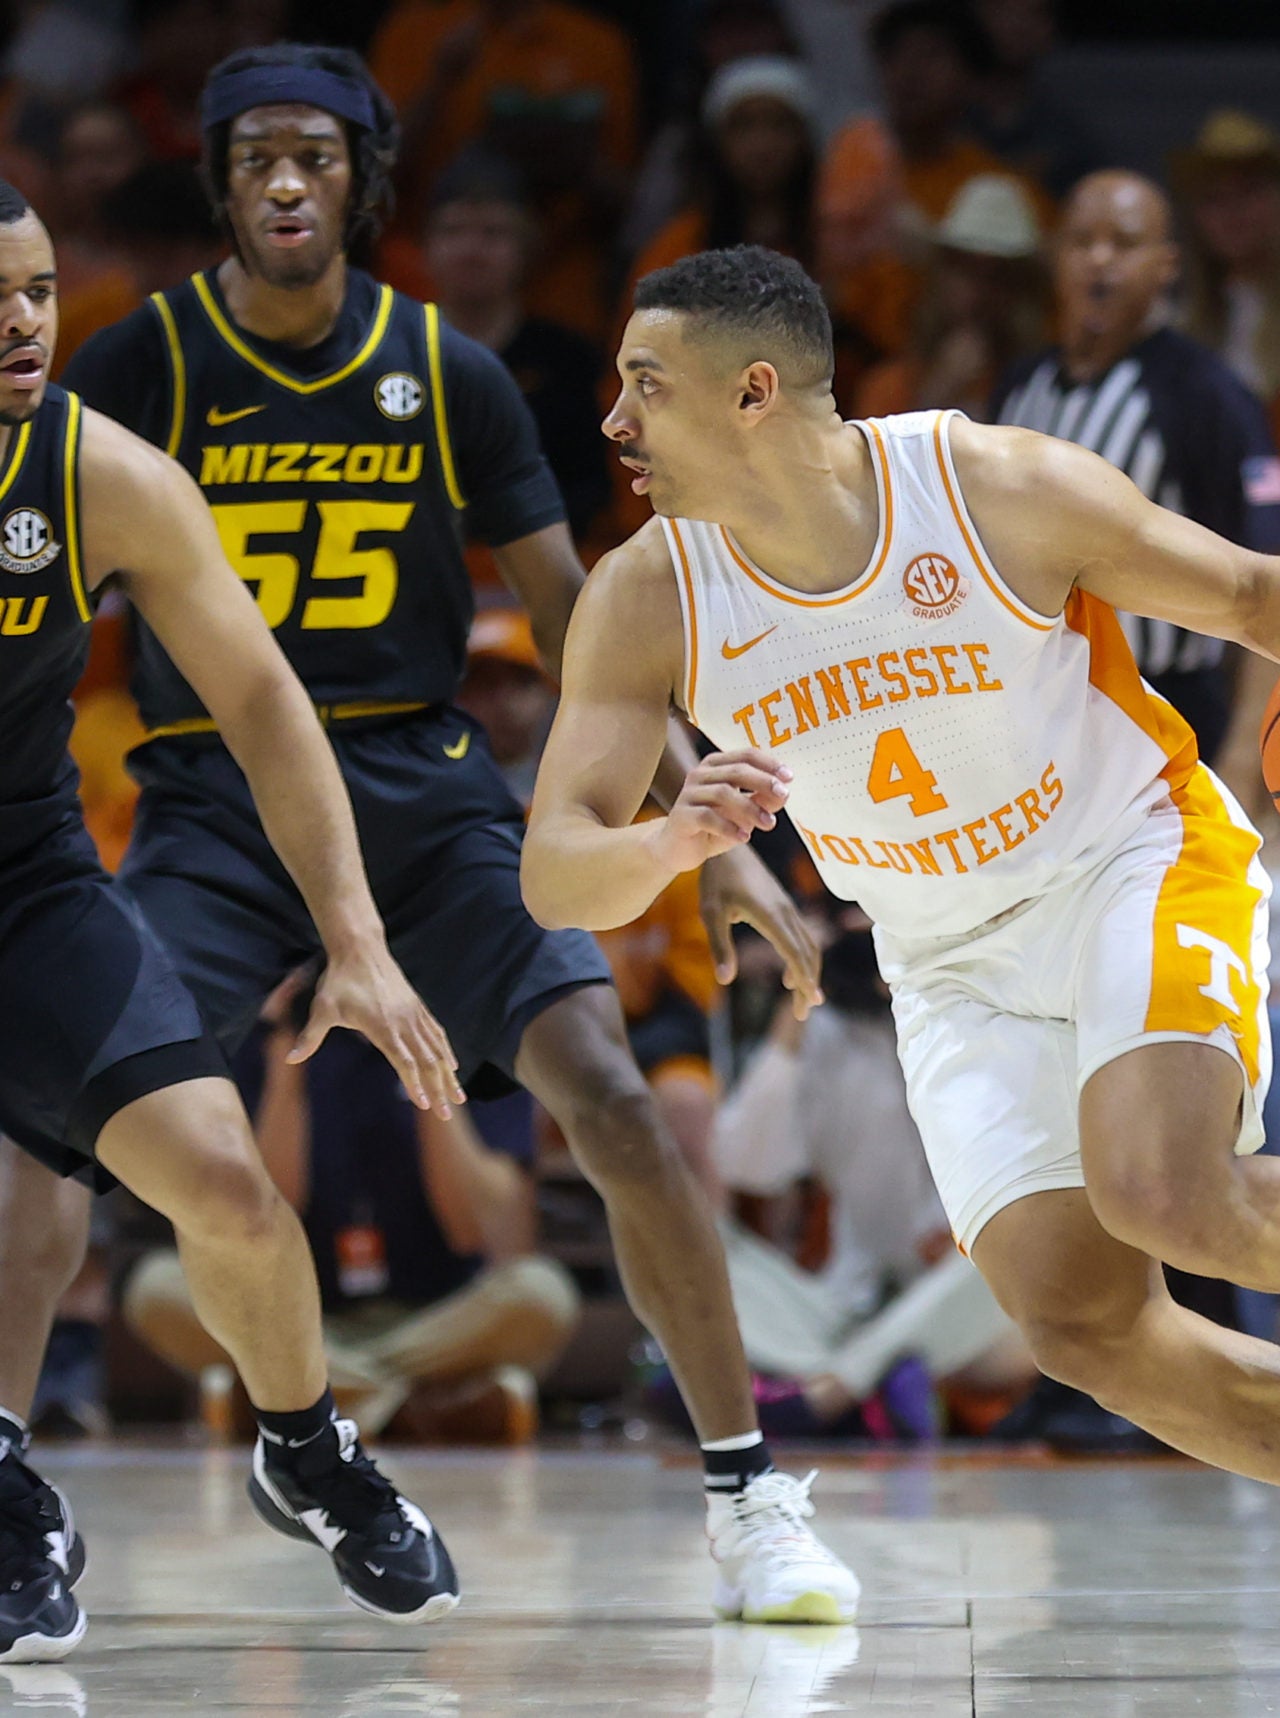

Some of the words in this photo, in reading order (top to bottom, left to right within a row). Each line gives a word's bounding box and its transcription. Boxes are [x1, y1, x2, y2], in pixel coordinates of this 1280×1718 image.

[199, 443, 424, 486] MIZZOU
[4, 511, 48, 557] SEC
[209, 499, 416, 629] 55
[907, 556, 955, 604] SEC
[0, 595, 50, 635] U
[912, 589, 967, 620] GRADUATE
[732, 643, 1004, 749] TENNESSEE
[866, 727, 949, 817] 4
